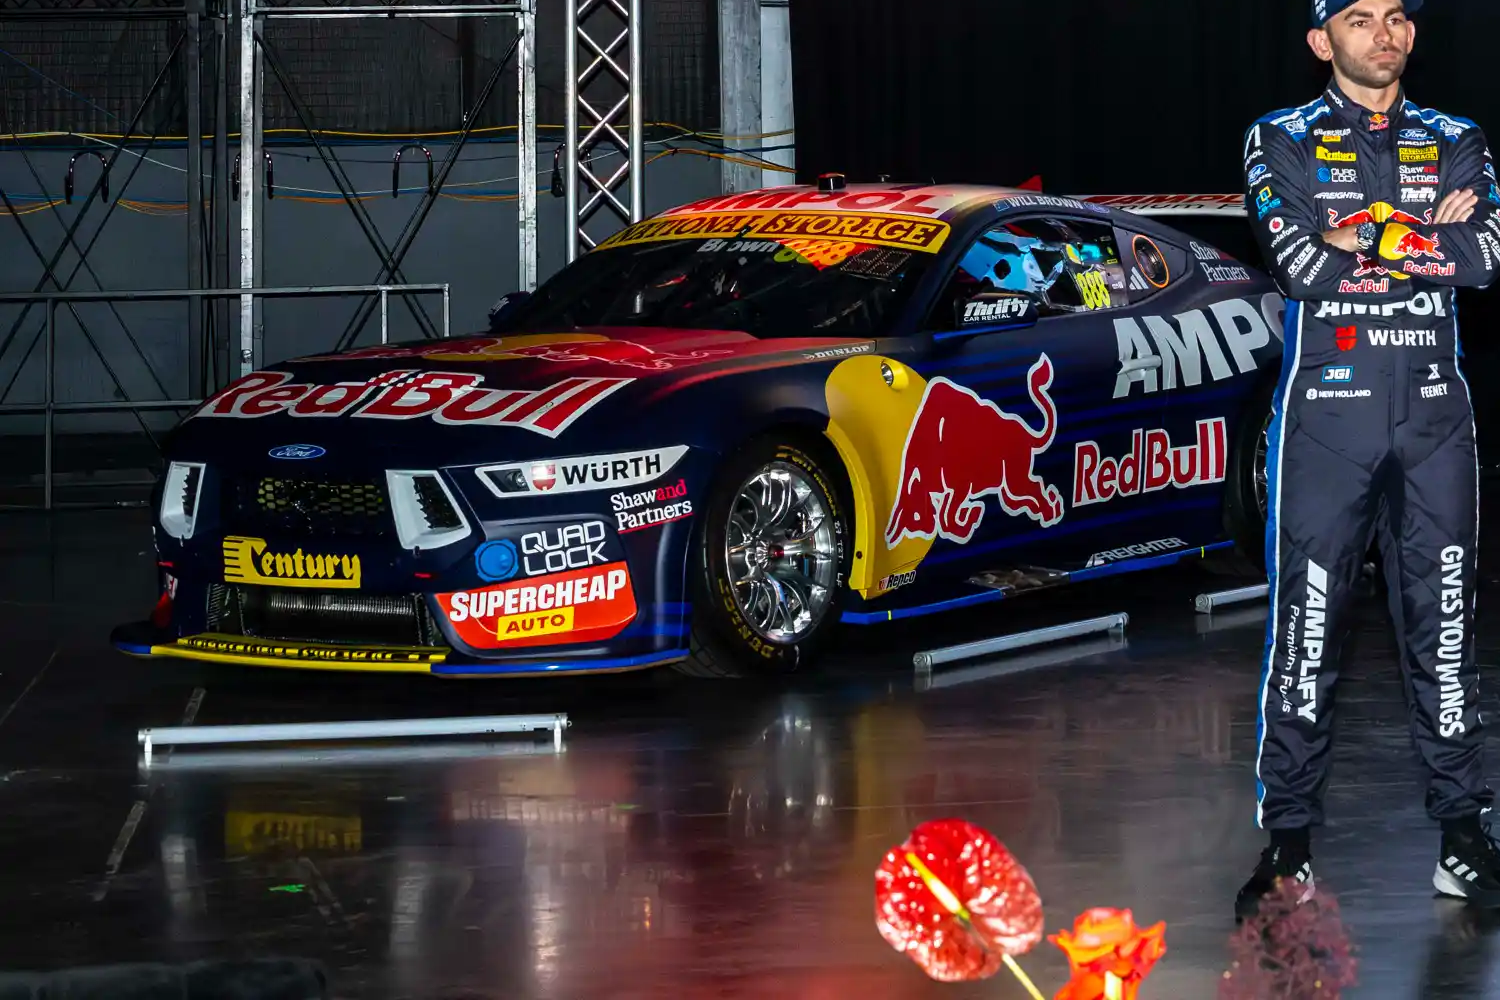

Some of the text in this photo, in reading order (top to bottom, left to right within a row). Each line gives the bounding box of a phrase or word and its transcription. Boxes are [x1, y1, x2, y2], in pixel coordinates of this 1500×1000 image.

[1331, 175, 1357, 183] LOCK
[1400, 174, 1438, 183] Partners
[671, 191, 948, 214] AMPOL
[1005, 196, 1037, 208] WILL
[1038, 197, 1084, 210] BROWN
[608, 212, 934, 245] NATIONAL STORAGE
[1271, 225, 1299, 248] vodafone
[1189, 241, 1220, 260] Shaw
[1476, 232, 1492, 271] Suttons
[1200, 262, 1250, 281] Partners
[1303, 251, 1329, 286] Suttons
[1403, 260, 1455, 275] Red Bull
[1076, 271, 1111, 310] 888
[1338, 278, 1389, 292] Red Bull
[964, 297, 1029, 317] Thrifty
[981, 313, 1011, 321] RENTAL
[1367, 329, 1437, 346] WÜRTH
[814, 345, 869, 358] DUNLOP
[1324, 368, 1350, 380] JGI
[1318, 389, 1371, 398] NEW HOLLAND
[1420, 383, 1448, 398] FEENEY
[352, 370, 638, 438] Bull
[562, 453, 661, 485] WÜRTH
[1072, 416, 1228, 508] Red Bull
[610, 489, 657, 511] Shaw
[615, 500, 693, 531] Partners
[521, 521, 606, 553] QUAD
[523, 542, 609, 576] LOCK
[1094, 537, 1188, 562] FREIGHTER
[223, 536, 361, 588] Century
[887, 570, 916, 590] Repco
[450, 569, 627, 622] SUPERCHEAP
[506, 613, 566, 633] AUTO
[1284, 604, 1300, 671] Premium
[1435, 545, 1465, 738] GIVES YOU WINGS
[1297, 585, 1327, 724] AMPLIFY
